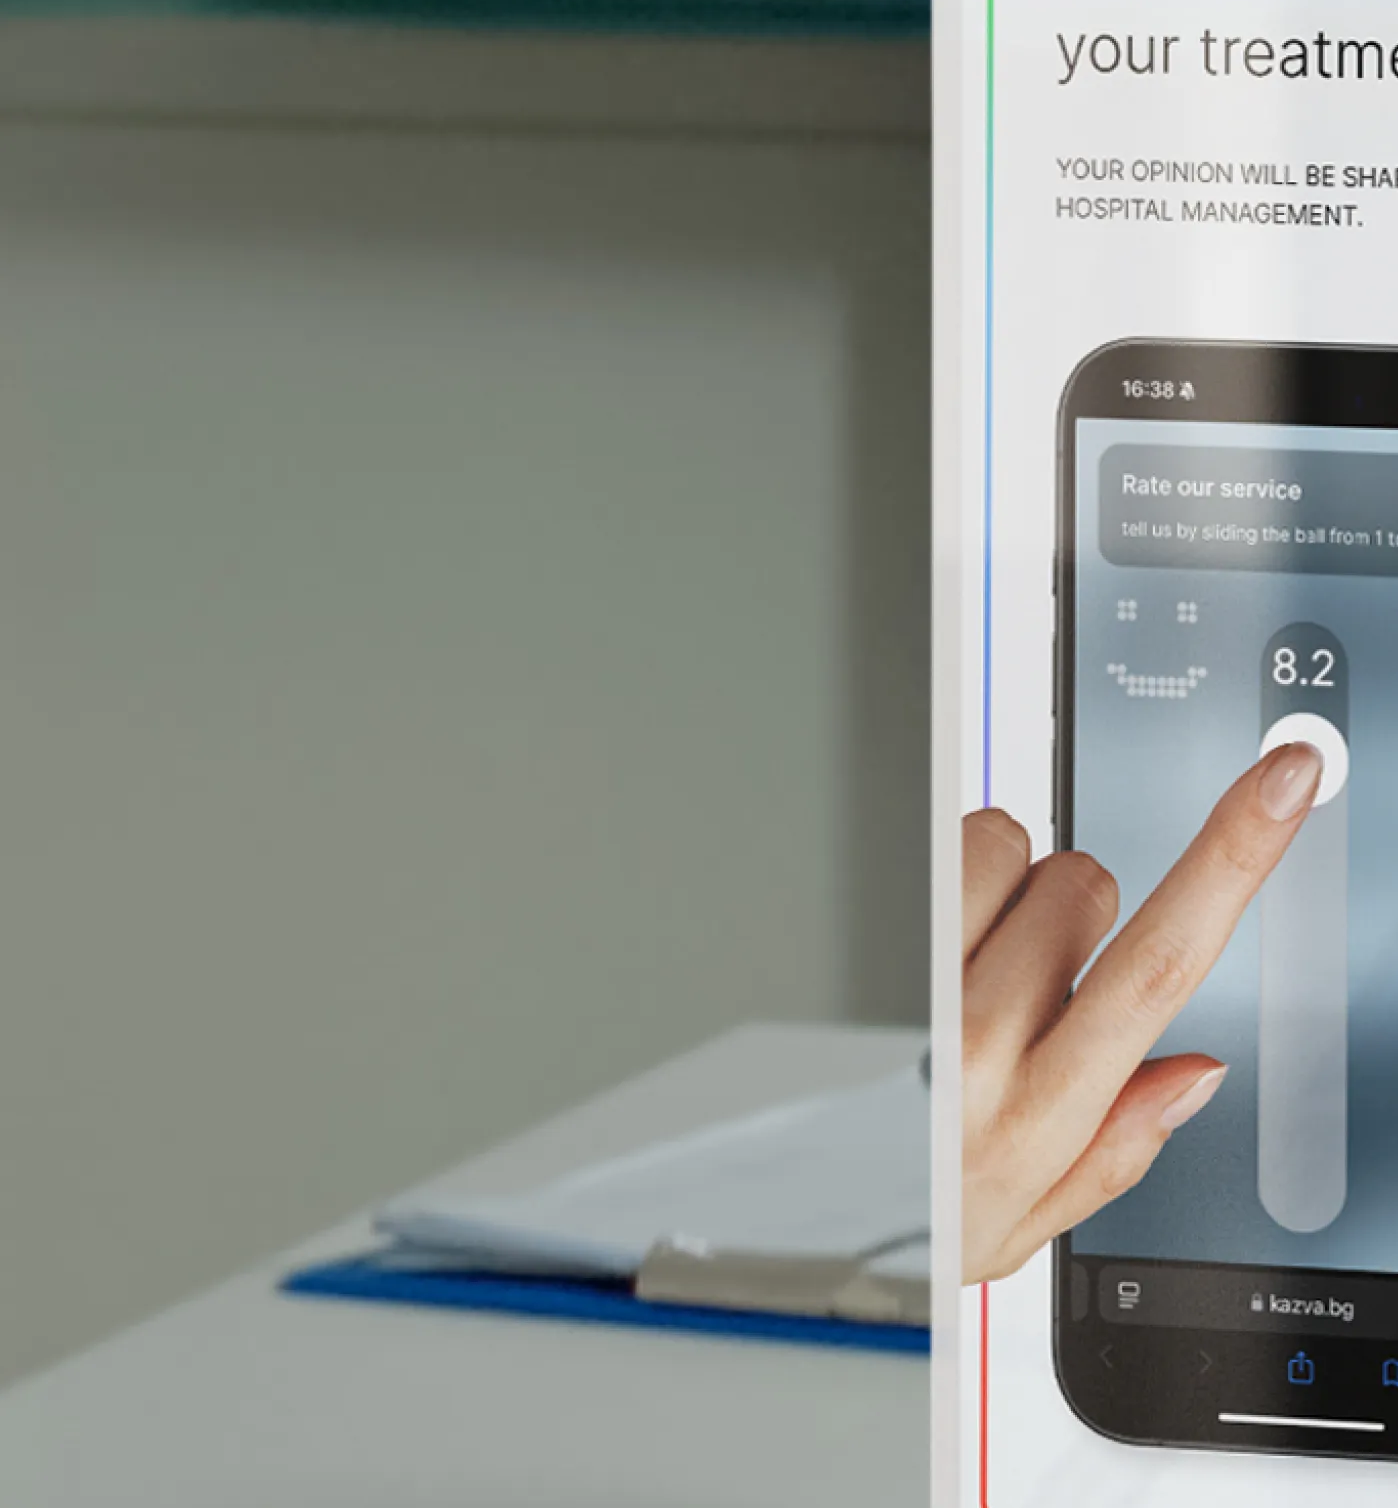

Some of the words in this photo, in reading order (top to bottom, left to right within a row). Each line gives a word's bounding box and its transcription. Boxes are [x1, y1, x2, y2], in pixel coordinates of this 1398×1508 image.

[1057, 34, 1179, 84] your
[1057, 158, 1124, 180] YOUR
[1132, 160, 1233, 183] OPINION
[1241, 164, 1298, 186] WILL
[1306, 164, 1335, 187] BE
[1056, 197, 1173, 221] HOSPITAL
[1183, 201, 1362, 227] MANAGEMENT.
[1123, 381, 1174, 399] 16:38
[1124, 475, 1171, 495] Rate
[1178, 481, 1214, 496] our
[1220, 479, 1300, 499] service
[1122, 522, 1147, 536] tell
[1152, 524, 1172, 538] us
[1177, 523, 1197, 541] by
[1202, 524, 1257, 545] sliding
[1262, 527, 1289, 541] the
[1295, 527, 1325, 543] ball
[1330, 528, 1370, 545] from
[1273, 647, 1333, 686] 8.2
[1270, 1294, 1354, 1321] kazva.bg
